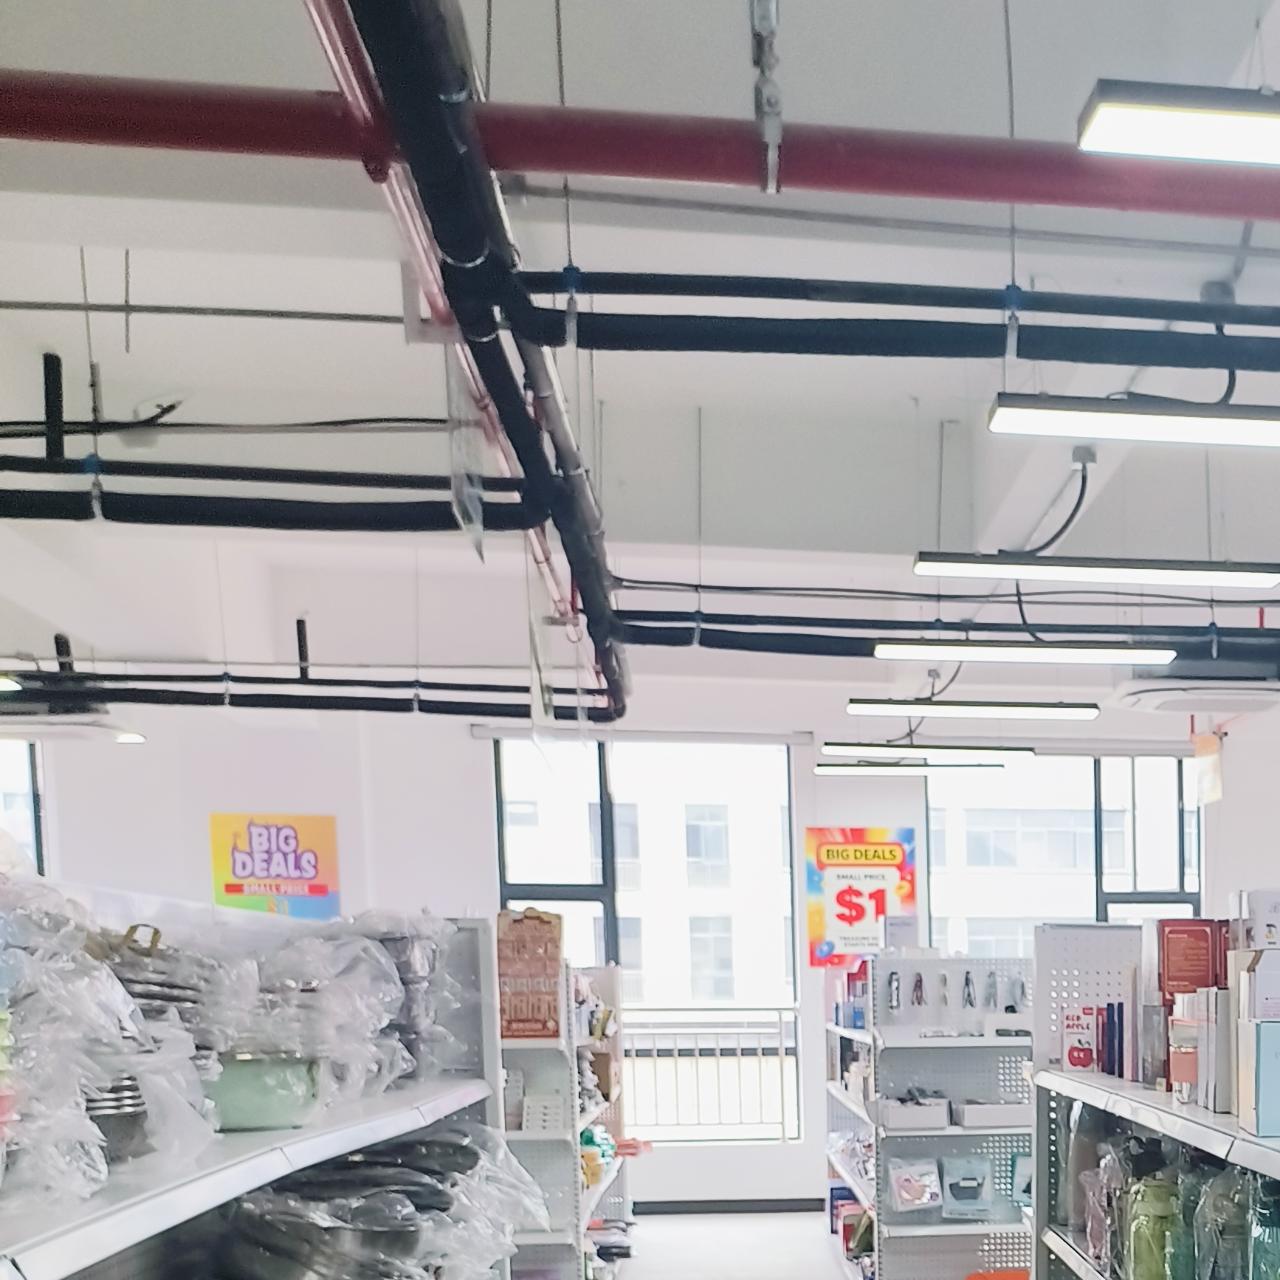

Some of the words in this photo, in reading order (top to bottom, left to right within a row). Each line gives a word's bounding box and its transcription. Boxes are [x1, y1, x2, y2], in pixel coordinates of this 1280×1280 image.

[248, 824, 299, 853] BIG
[232, 848, 318, 880] DEALS
[826, 849, 850, 860] BIG
[853, 849, 897, 861] DEALS
[835, 885, 886, 927] $1
